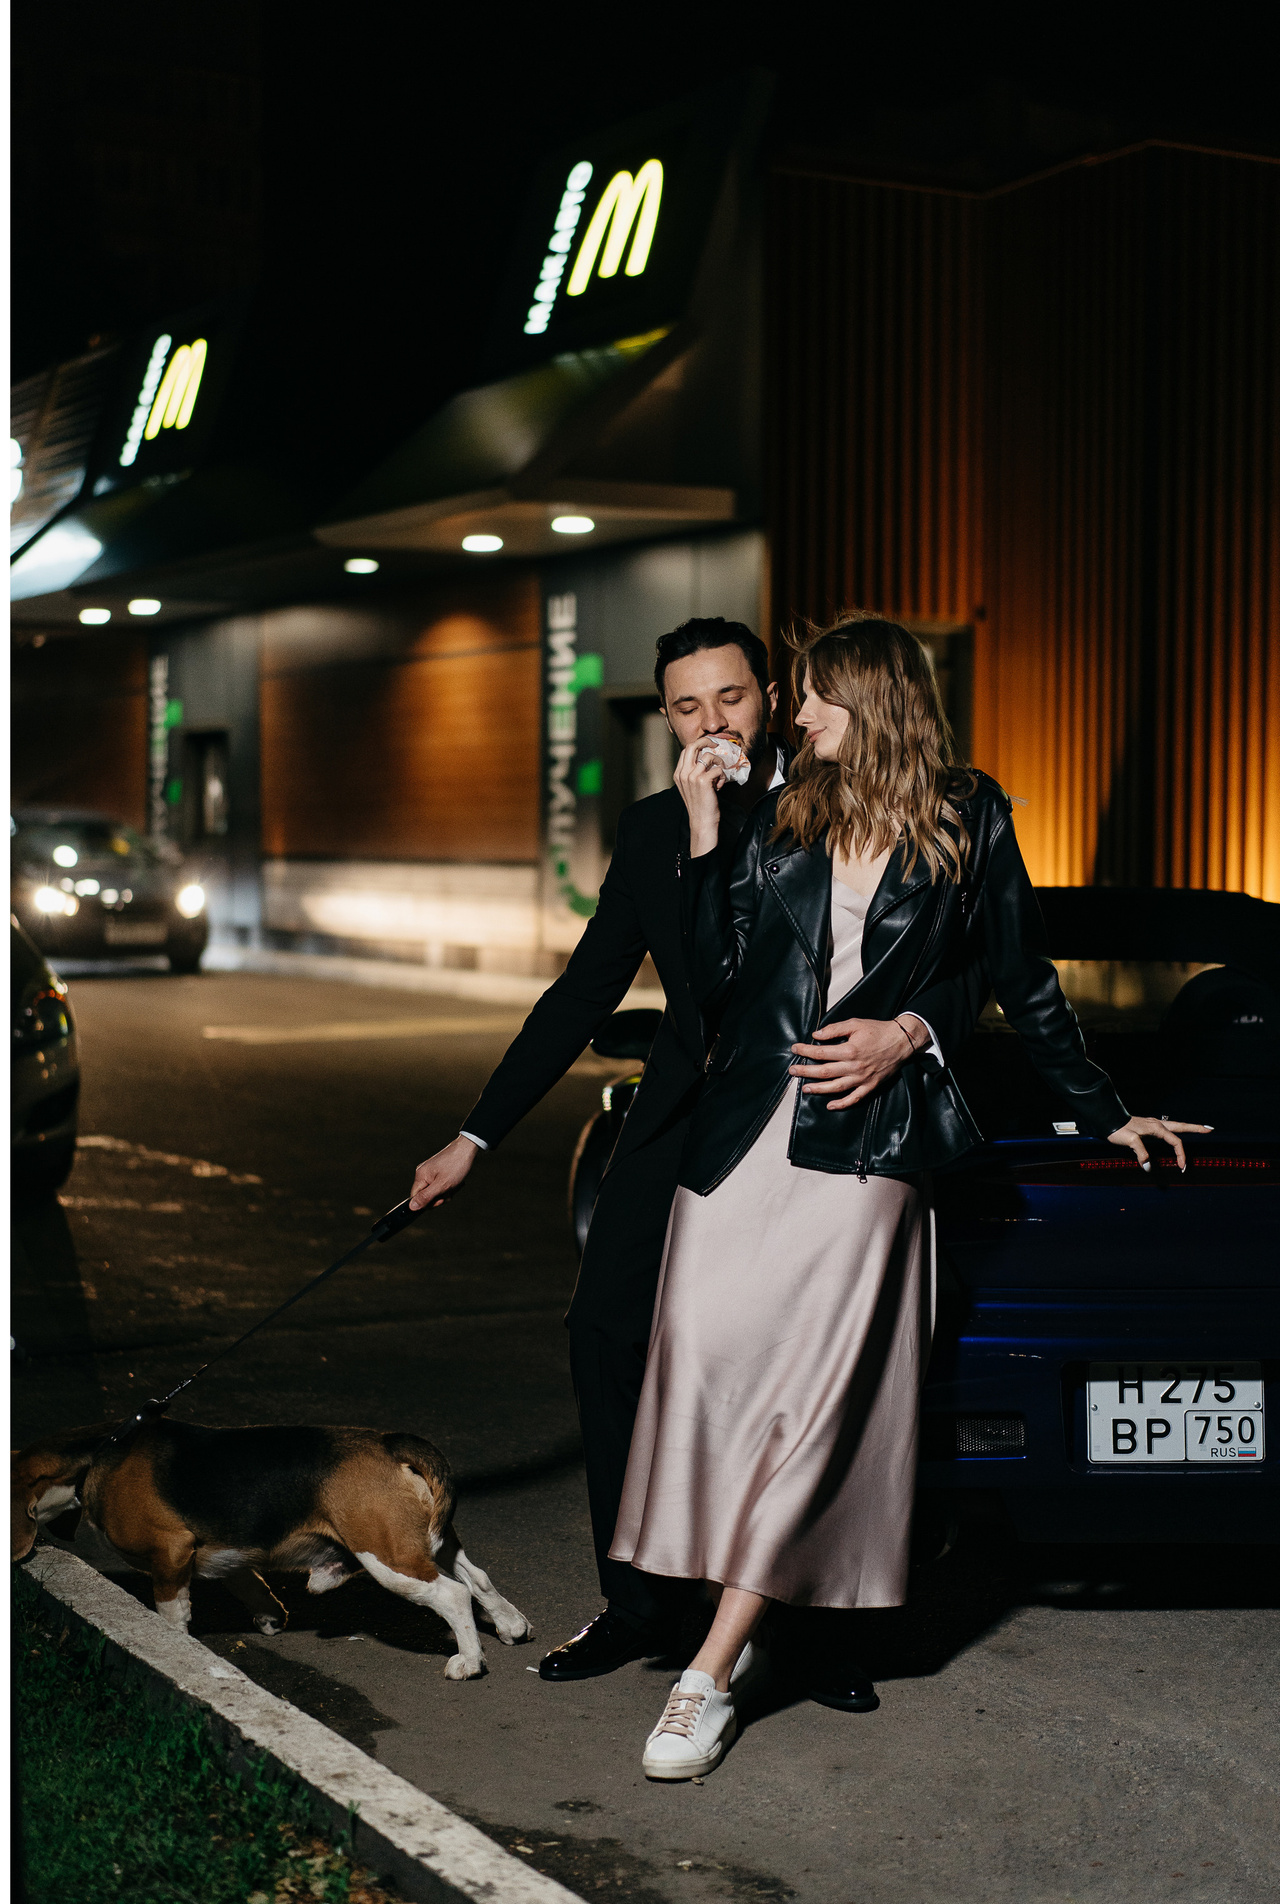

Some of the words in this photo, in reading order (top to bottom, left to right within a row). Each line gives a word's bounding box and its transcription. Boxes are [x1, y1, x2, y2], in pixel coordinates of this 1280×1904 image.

[1160, 1365, 1236, 1404] 275
[1194, 1416, 1256, 1445] 750
[1210, 1447, 1237, 1458] RUS
